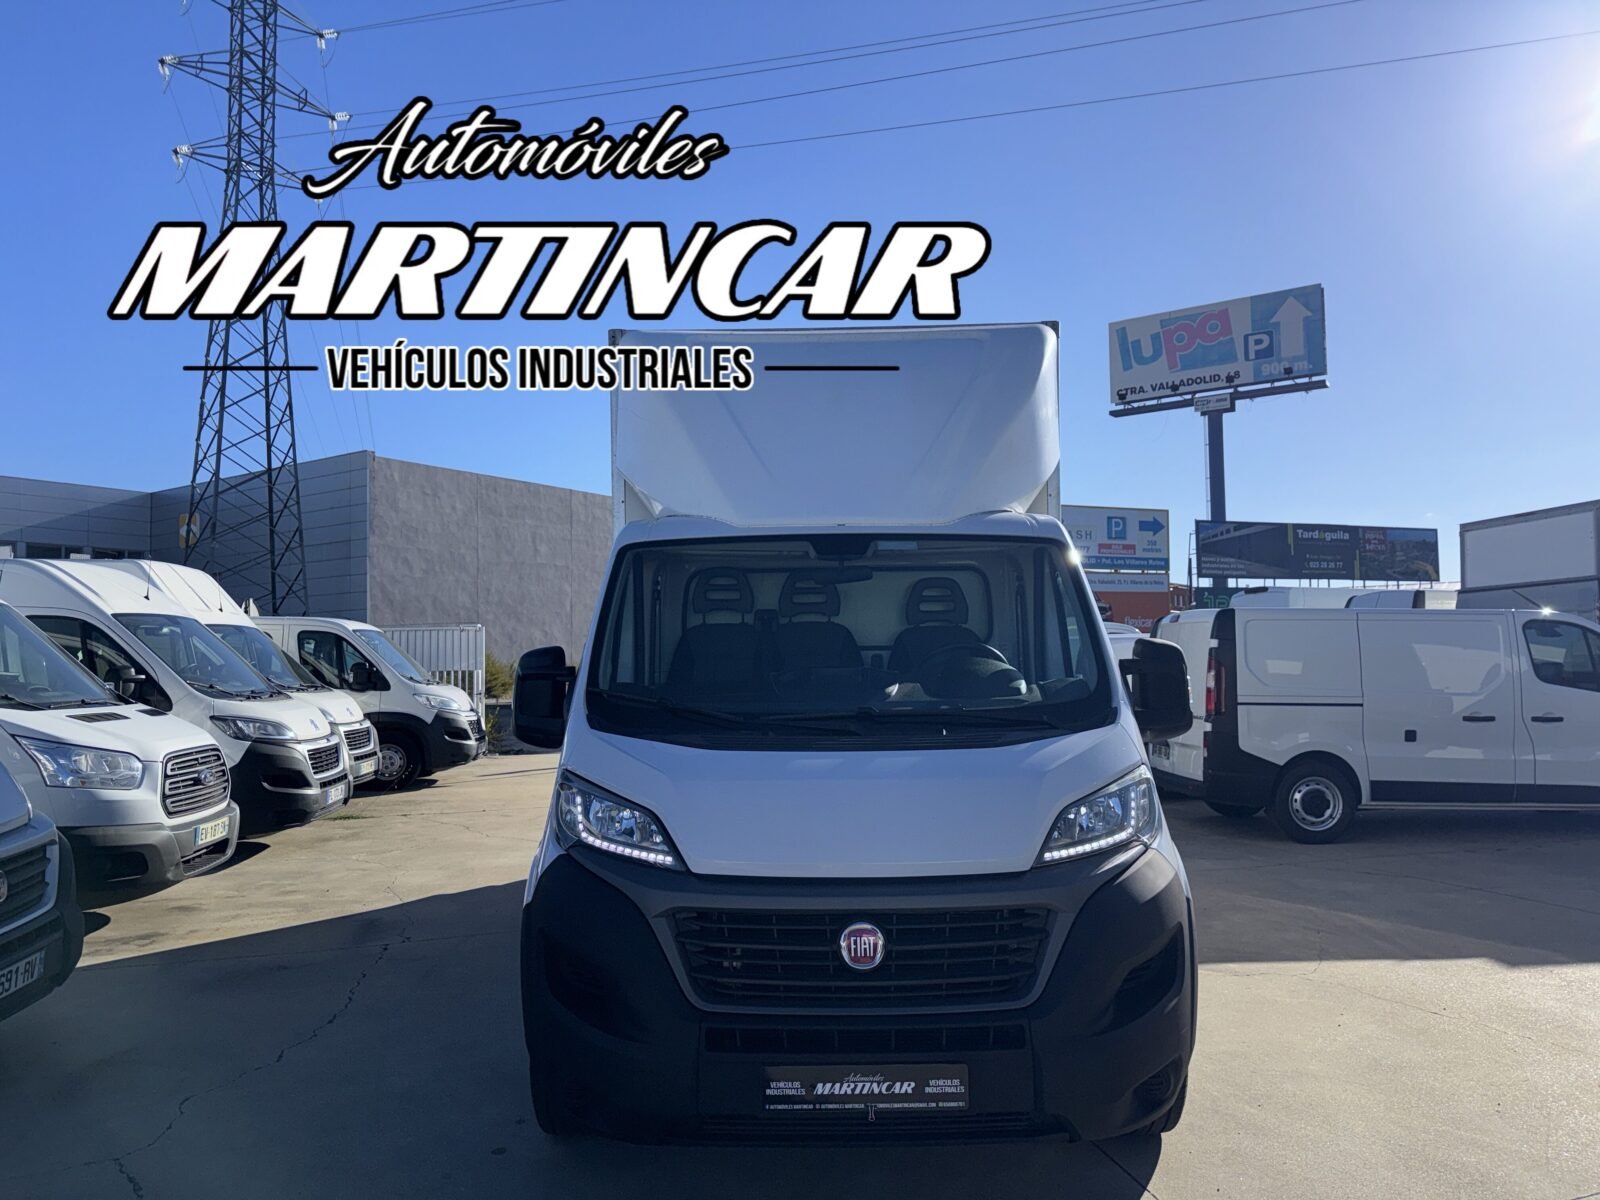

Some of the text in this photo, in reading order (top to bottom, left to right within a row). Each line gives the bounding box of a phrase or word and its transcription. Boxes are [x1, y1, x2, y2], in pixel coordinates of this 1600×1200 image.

[1115, 307, 1233, 372] lupa
[1248, 333, 1271, 360] P
[850, 936, 876, 957] FIAT
[765, 1088, 806, 1096] INDUSTRIALES
[813, 1081, 916, 1095] MARTINCAR
[924, 1086, 965, 1094] INDUSTRIALES
